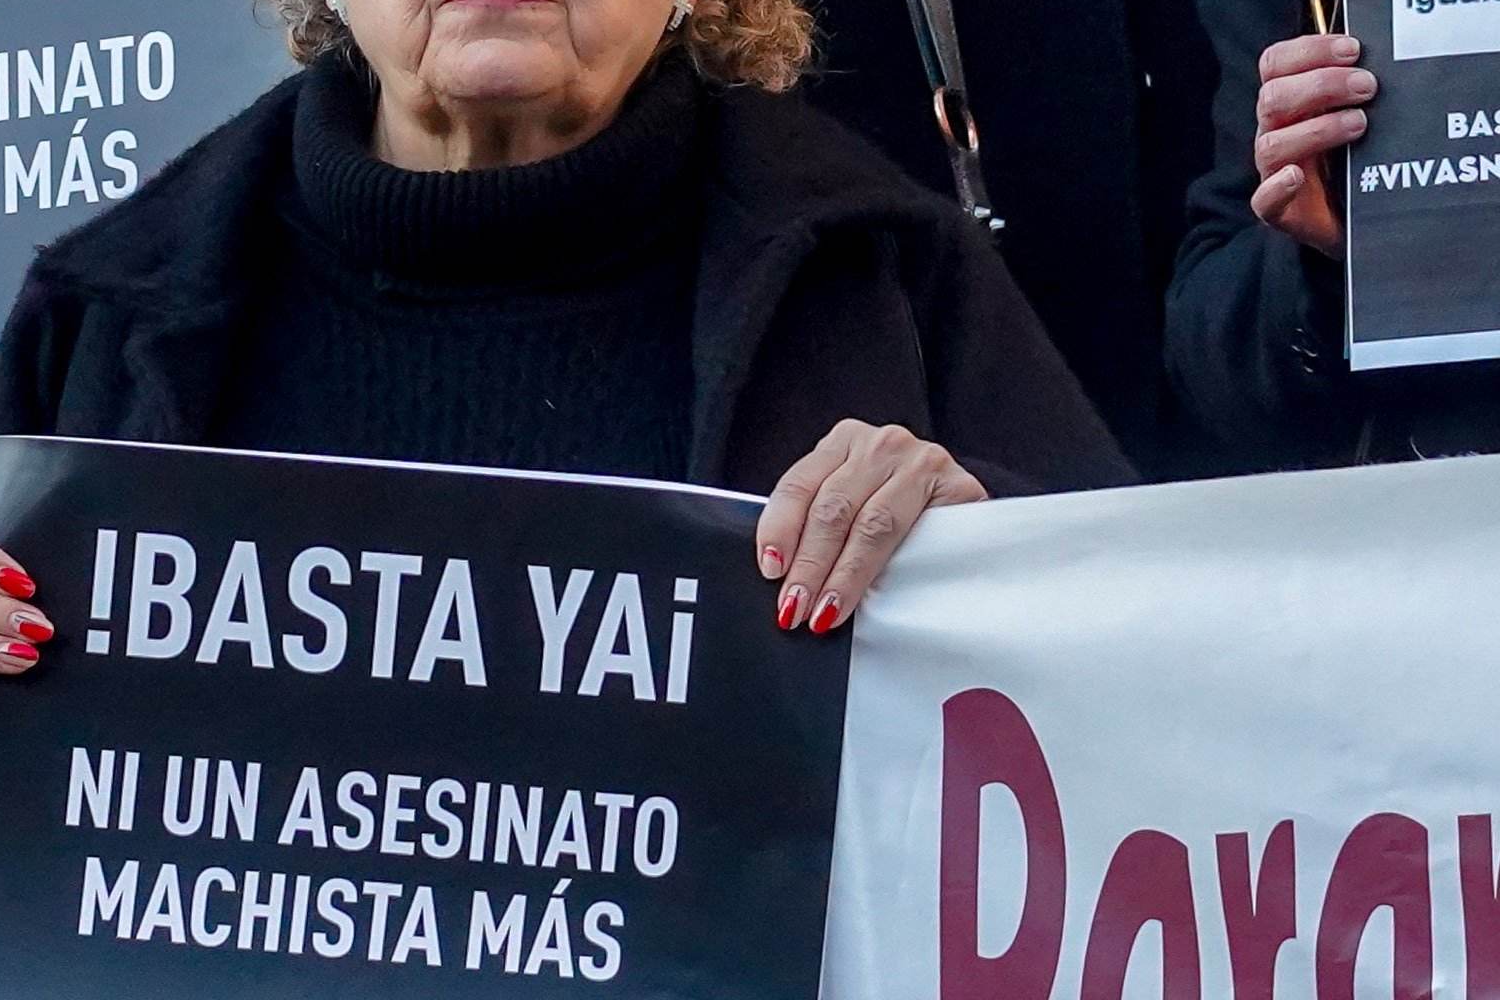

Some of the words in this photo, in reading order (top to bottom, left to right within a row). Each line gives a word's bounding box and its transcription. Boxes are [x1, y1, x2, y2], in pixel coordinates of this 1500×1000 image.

[4, 118, 139, 214] MÁS
[85, 528, 488, 687] !BASTA
[65, 747, 139, 832] NI
[162, 756, 261, 841] UN
[279, 766, 679, 878] ASESINATO
[77, 857, 442, 968] MACHISTA
[466, 878, 625, 983] MÁS
